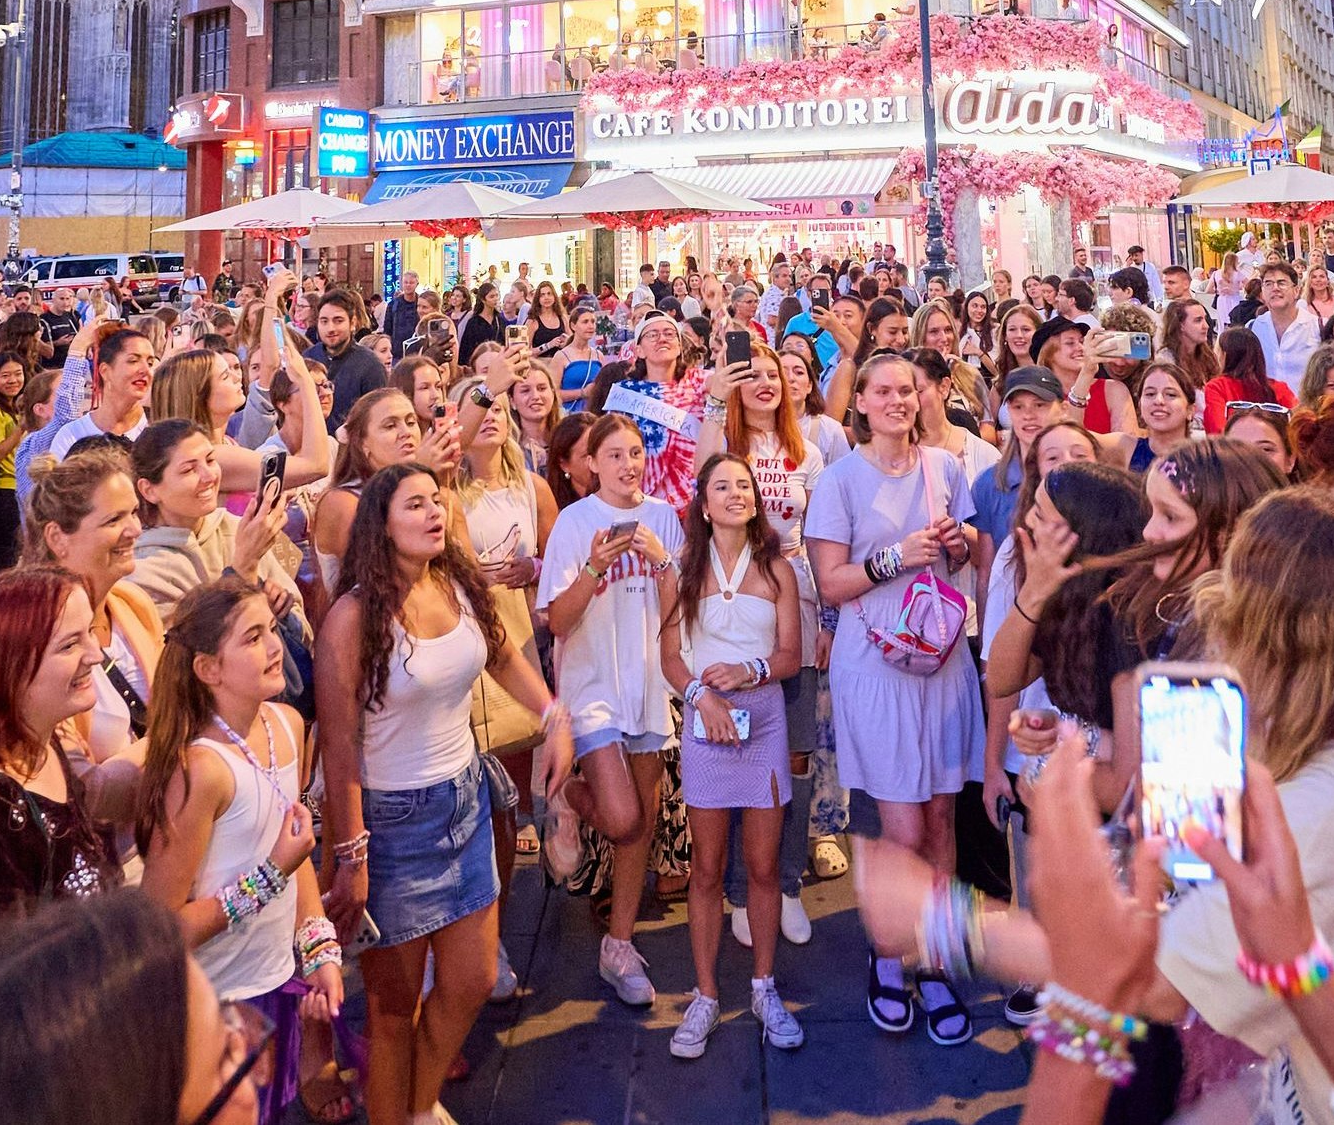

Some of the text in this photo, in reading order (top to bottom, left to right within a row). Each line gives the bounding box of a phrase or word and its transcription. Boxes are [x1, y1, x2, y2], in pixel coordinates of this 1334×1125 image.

[592, 94, 910, 139] CAFE KONDITOREI
[374, 127, 451, 164] MONEY
[453, 119, 575, 160] EXCHANGE
[382, 185, 414, 198] THE
[496, 180, 549, 196] GROUP
[756, 458, 781, 470] BUT
[755, 472, 790, 484] ADDY
[761, 486, 792, 499] OVE
